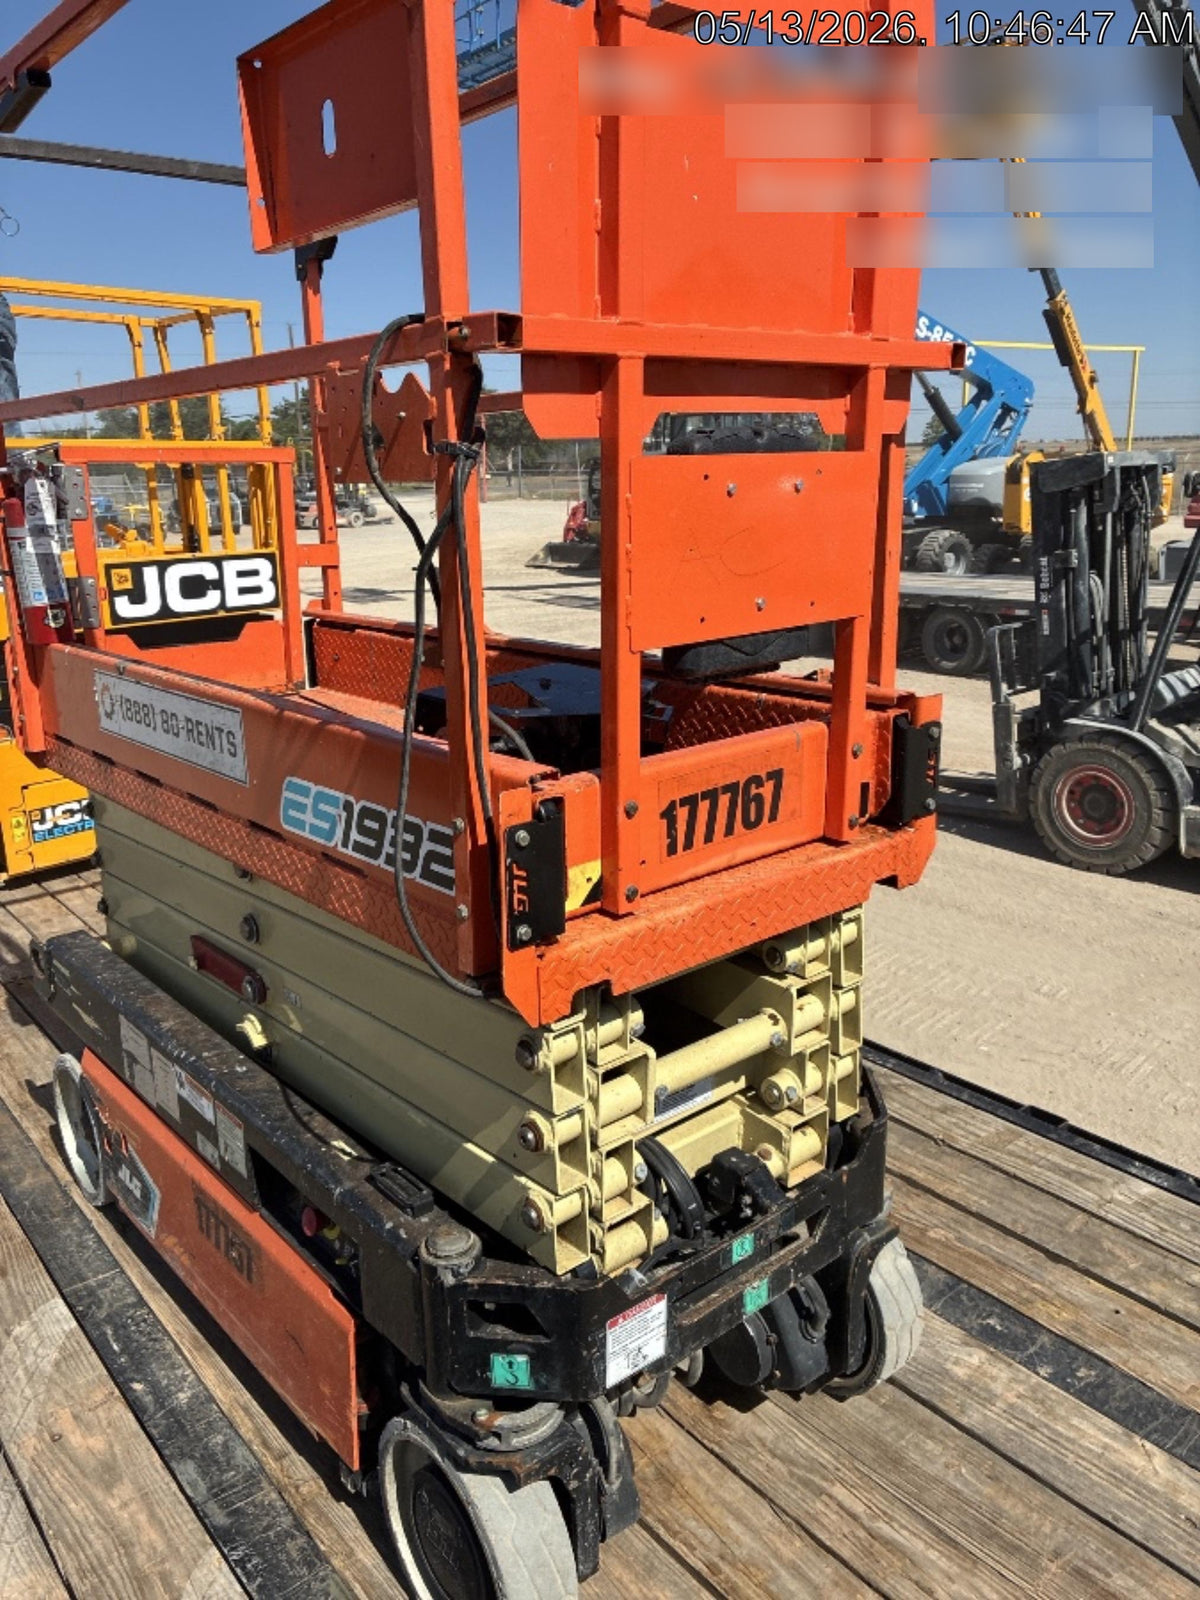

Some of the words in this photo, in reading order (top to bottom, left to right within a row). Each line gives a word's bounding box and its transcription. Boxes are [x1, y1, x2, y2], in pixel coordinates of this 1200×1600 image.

[113, 557, 276, 619] JCB
[119, 693, 157, 732] (888)
[160, 708, 237, 758] 80-RENTS
[280, 777, 456, 896] ES1932
[659, 767, 784, 858] 177767
[512, 863, 529, 915] JLG
